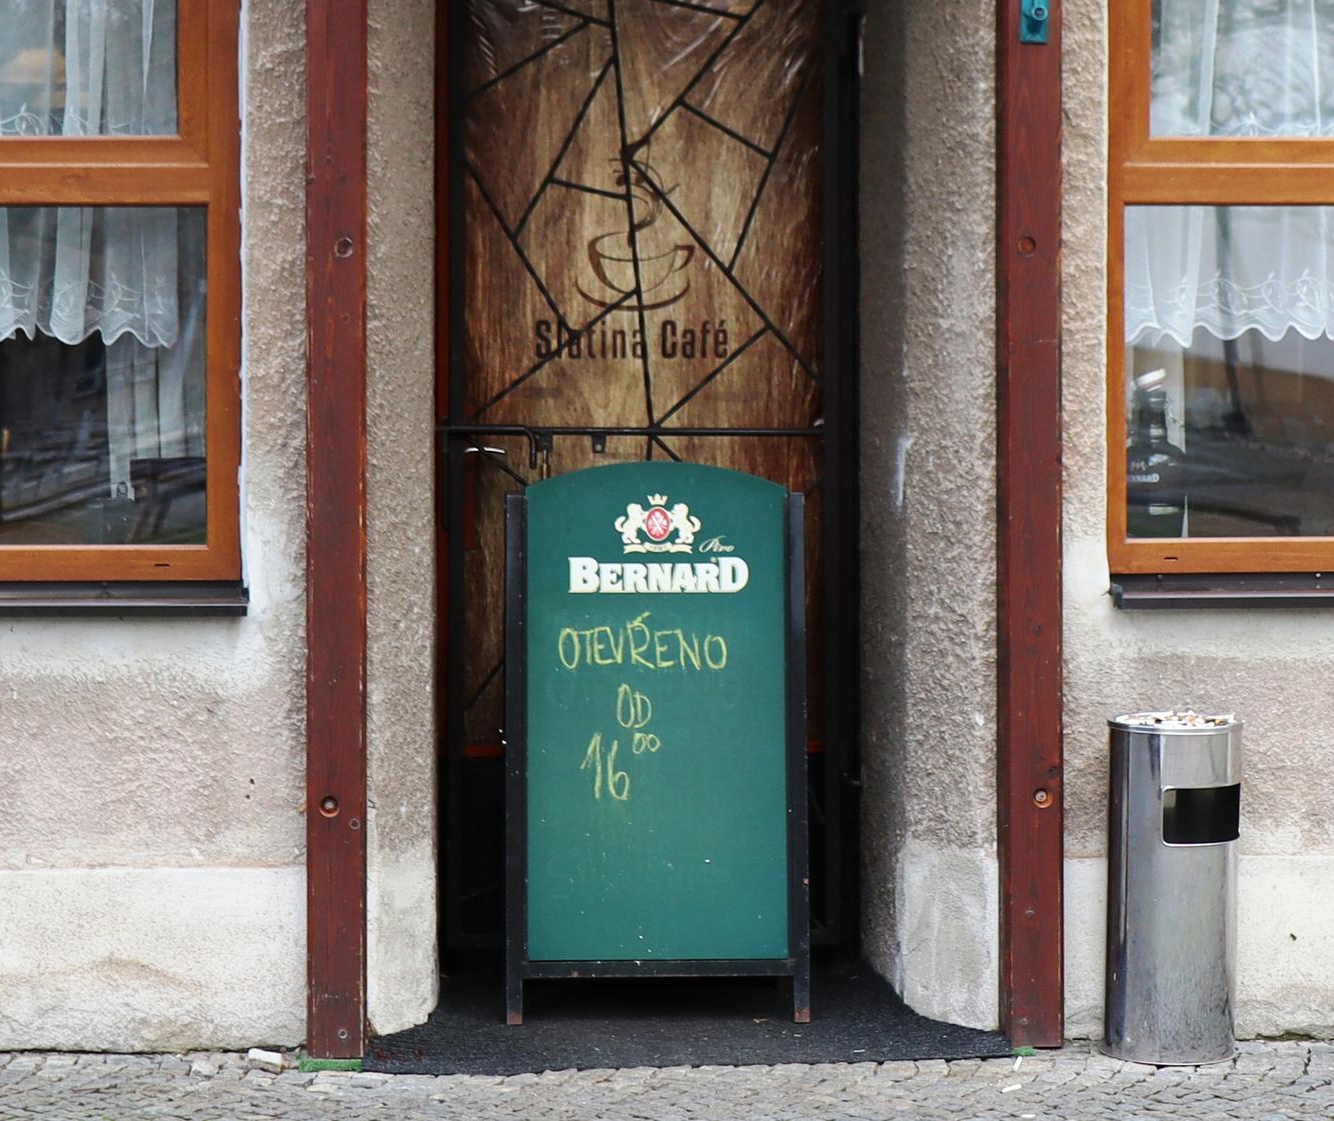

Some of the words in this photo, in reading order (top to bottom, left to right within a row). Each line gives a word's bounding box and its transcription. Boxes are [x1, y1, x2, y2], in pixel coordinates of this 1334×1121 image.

[535, 319, 645, 359] Slatina
[661, 318, 729, 359] Café
[698, 534, 736, 553] Pivo
[568, 556, 750, 594] BERNARD
[557, 611, 728, 671] OTEVŘENO
[616, 683, 652, 729] OD
